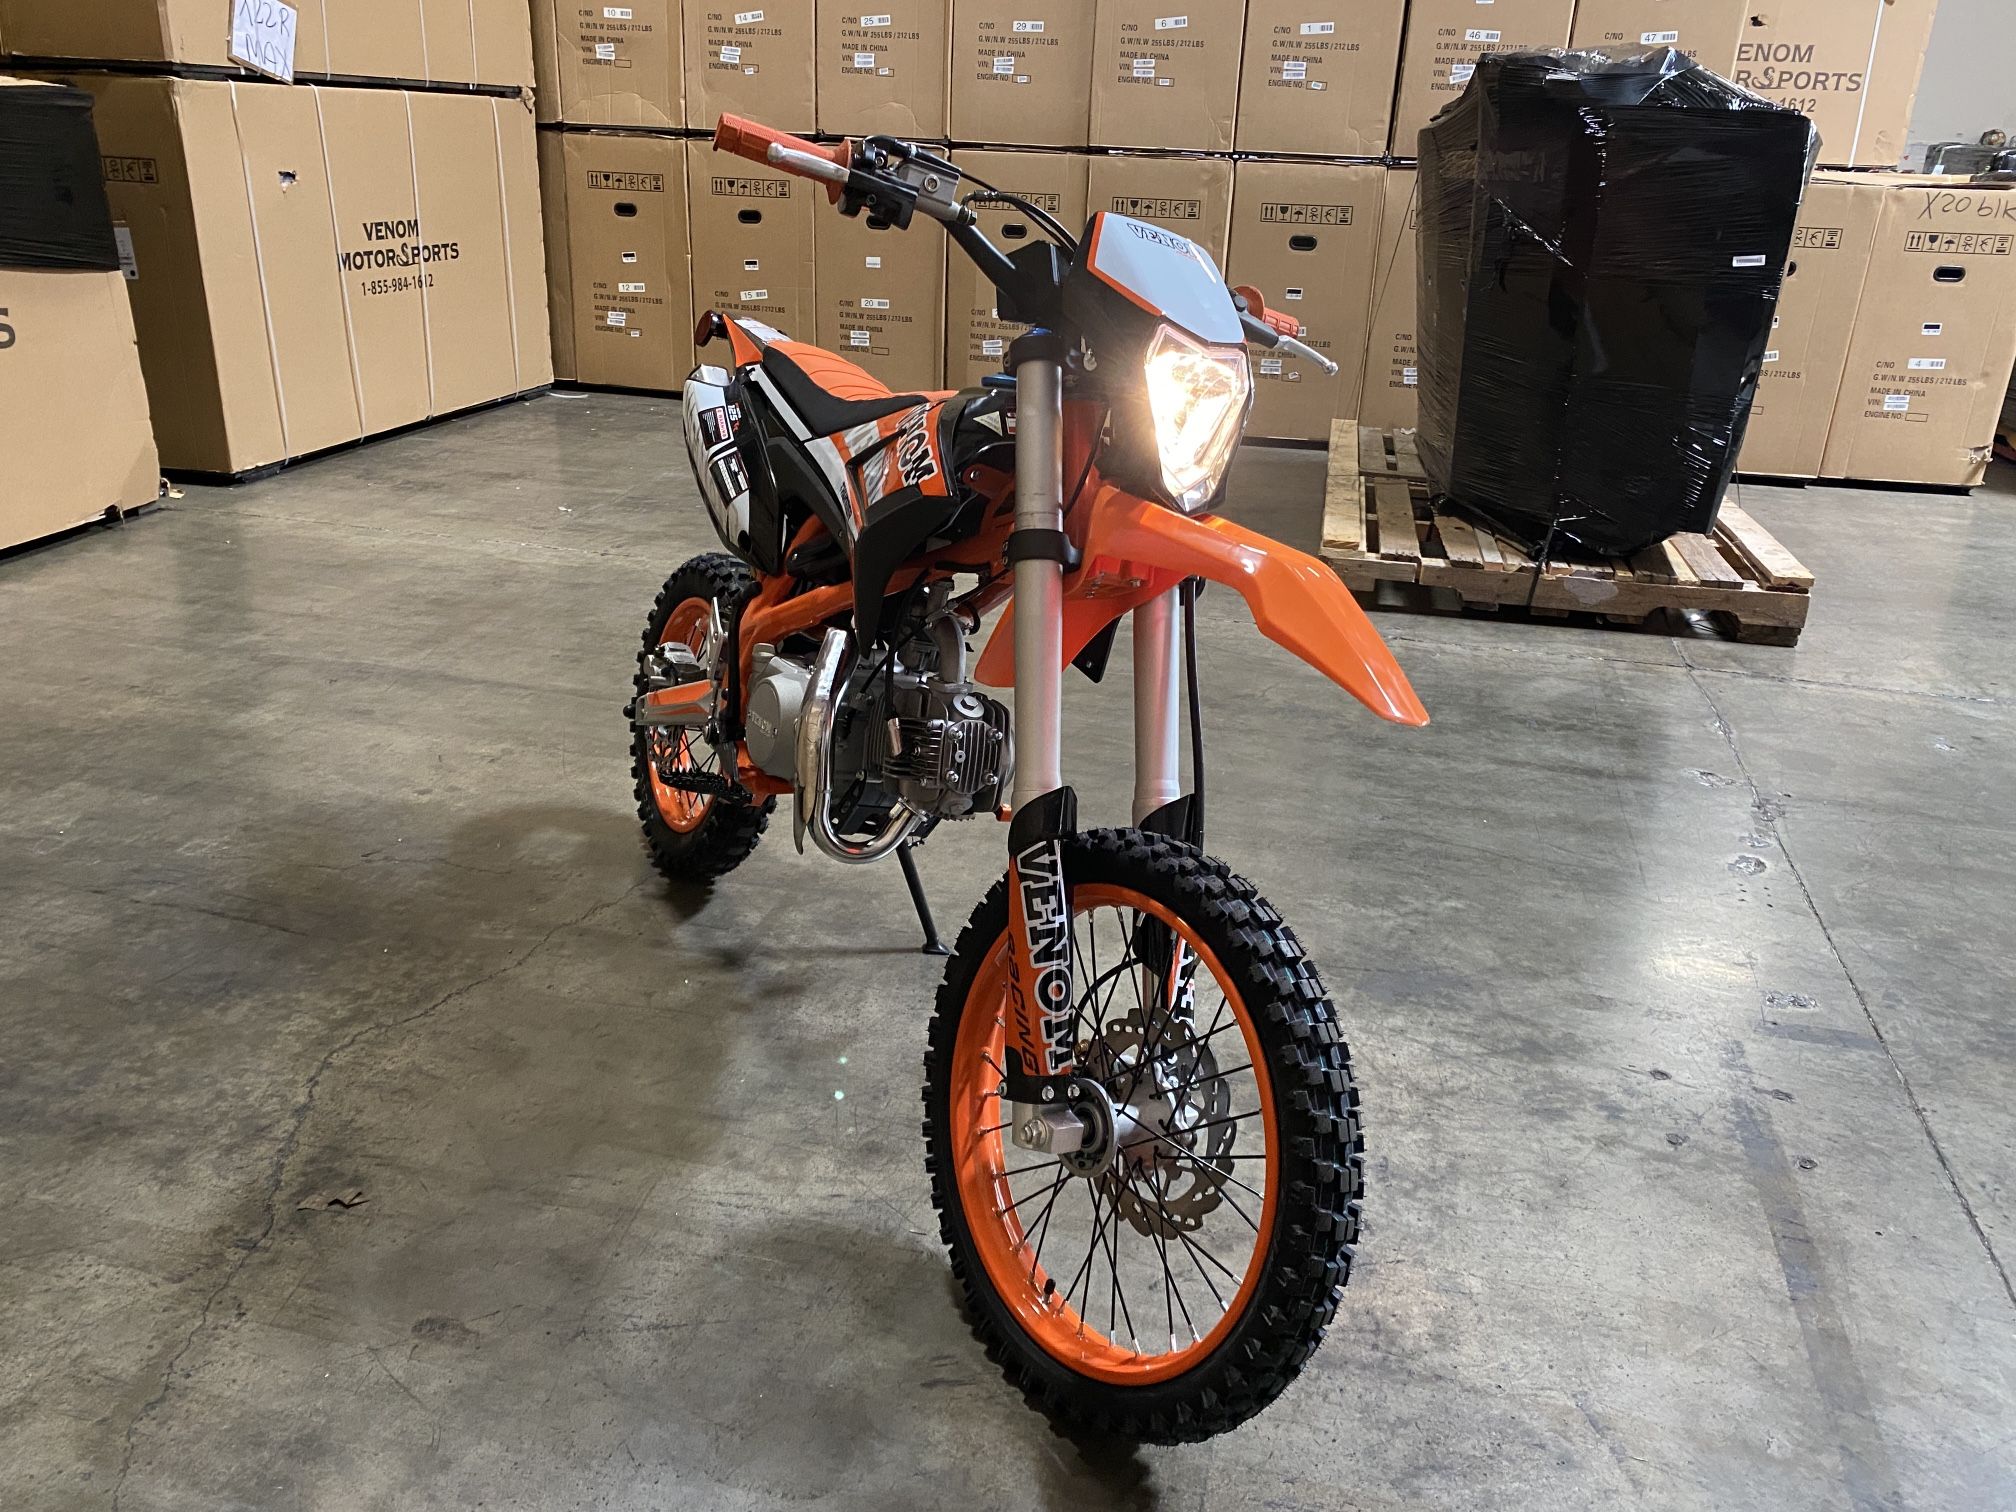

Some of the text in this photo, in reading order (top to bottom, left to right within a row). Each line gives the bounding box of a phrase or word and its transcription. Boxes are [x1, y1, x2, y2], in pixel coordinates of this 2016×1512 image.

[1469, 31, 1480, 39] 46
[1644, 34, 1656, 42] 47
[246, 34, 292, 79] MAX
[1149, 53, 1170, 61] CHINA
[1736, 44, 1815, 62] ENOM
[1302, 56, 1322, 64] CHINA
[1268, 79, 1292, 87] ENGINE
[1735, 66, 1862, 92] RSPORTS
[1431, 83, 1455, 91] ENGINE
[1917, 191, 1971, 220] X20
[362, 219, 419, 240] VENOM
[339, 242, 459, 272] MOTORSPORTS
[1903, 389, 1926, 397] CHINA
[728, 404, 738, 421] 125
[1864, 411, 1889, 419] ENGINE
[1016, 839, 1075, 1077] VENOM
